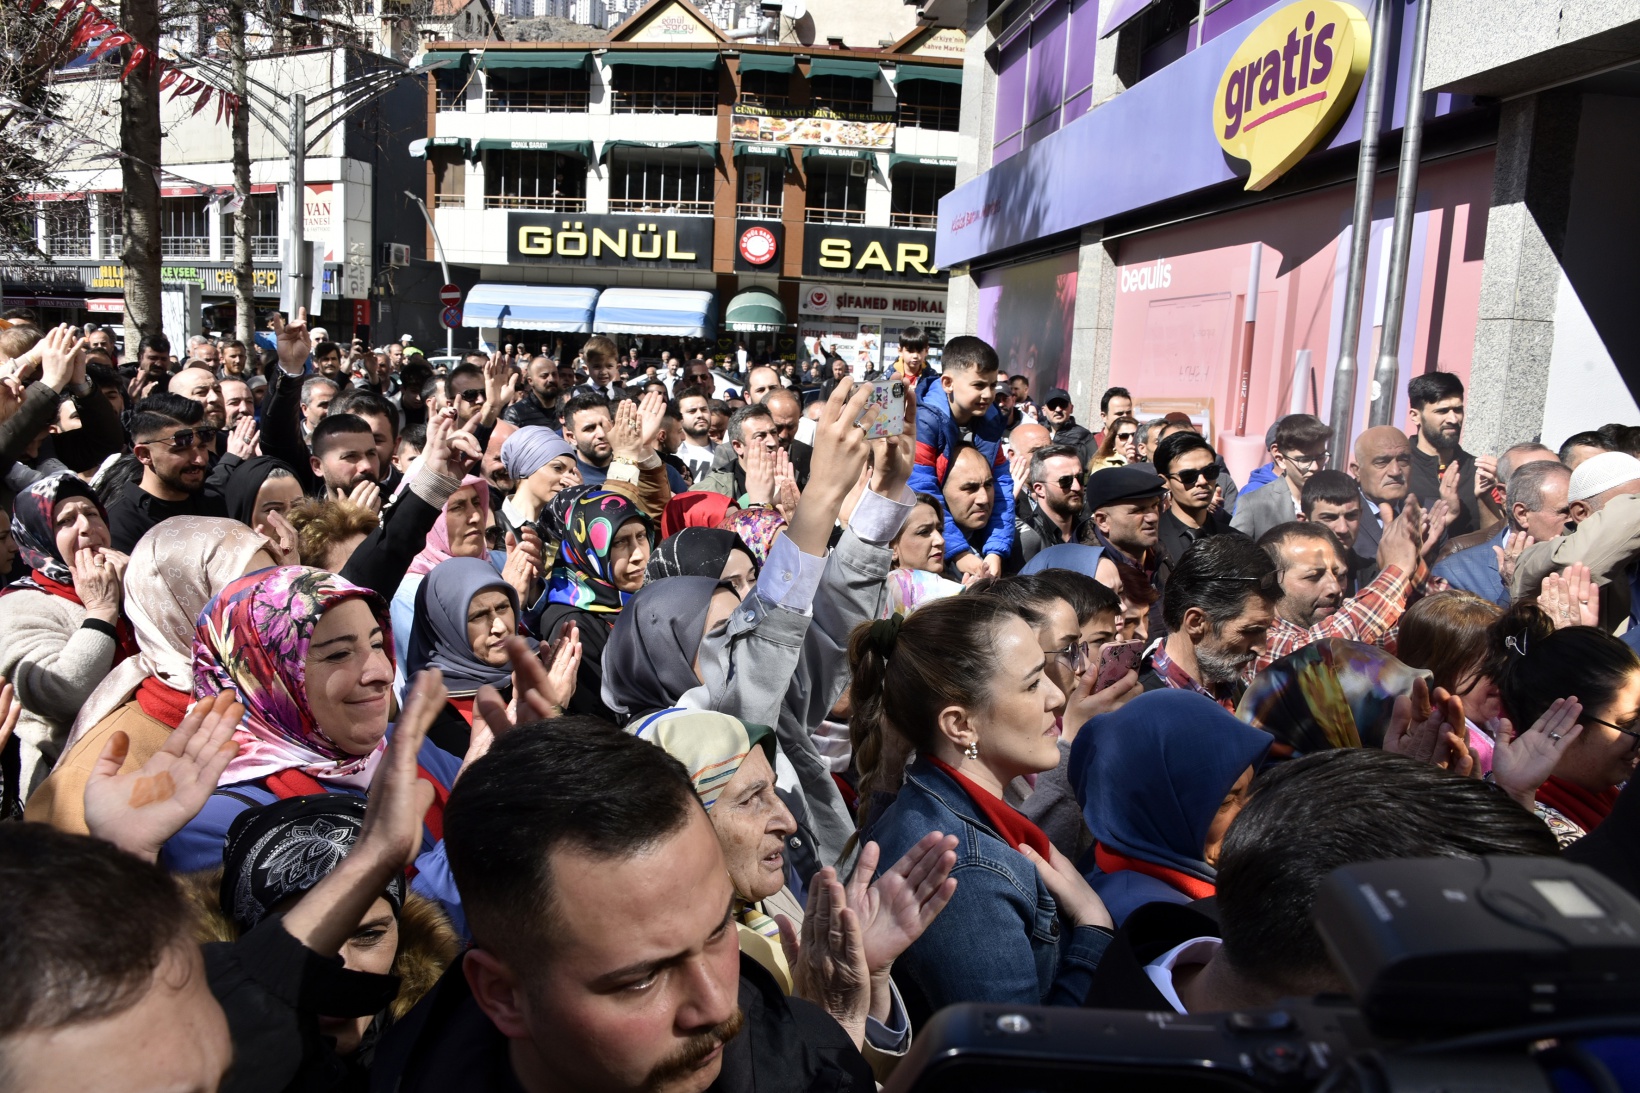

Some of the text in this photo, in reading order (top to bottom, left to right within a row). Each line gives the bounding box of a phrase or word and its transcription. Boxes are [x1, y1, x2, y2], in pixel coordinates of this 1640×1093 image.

[1224, 10, 1336, 140] gratis
[518, 221, 939, 275] GÖNÜL SAR
[1121, 256, 1172, 293] beaulis
[836, 291, 888, 310] ŞİFAMED
[892, 297, 945, 314] MEDİKAL
